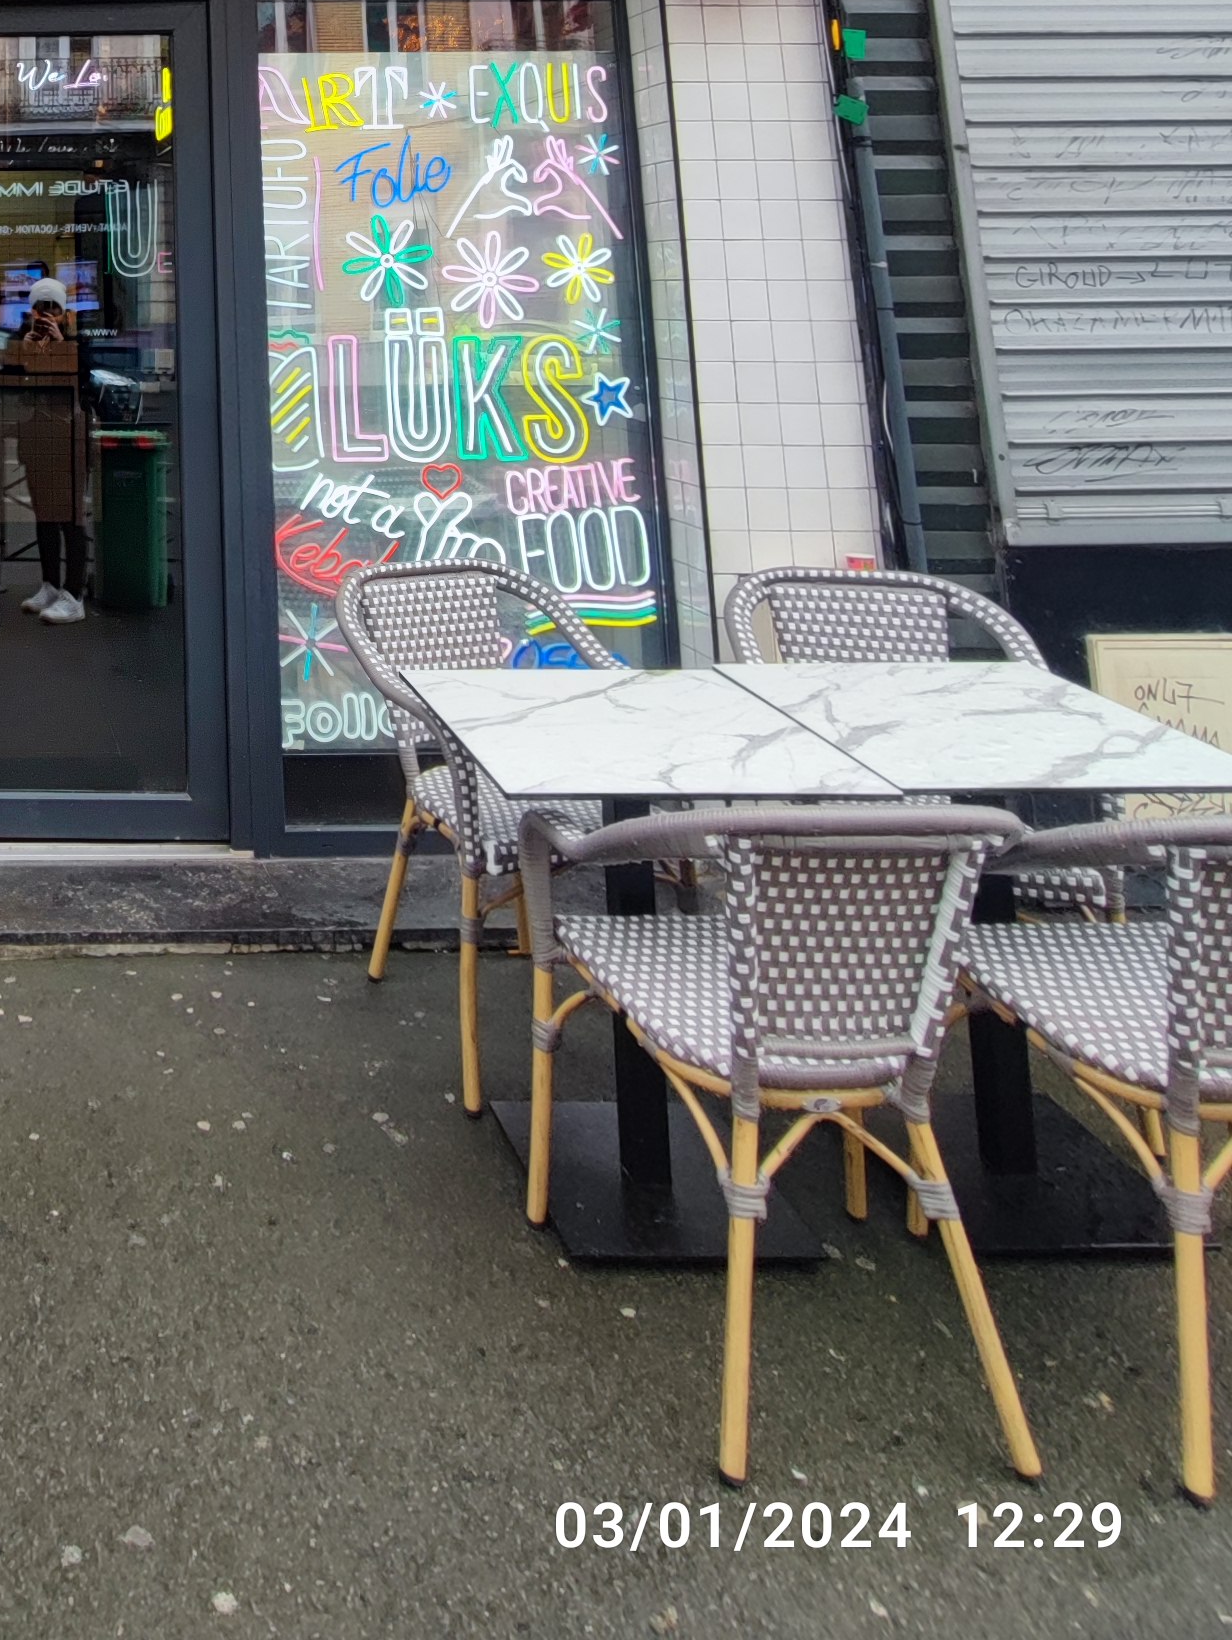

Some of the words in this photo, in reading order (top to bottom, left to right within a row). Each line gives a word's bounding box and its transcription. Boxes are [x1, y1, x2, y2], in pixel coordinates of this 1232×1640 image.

[468, 62, 608, 133] EXQUIS
[335, 134, 452, 209] Folie
[328, 307, 589, 464] LÜKS
[299, 472, 391, 525] not
[505, 458, 641, 516] CREATIVE
[516, 505, 651, 594] FOOD
